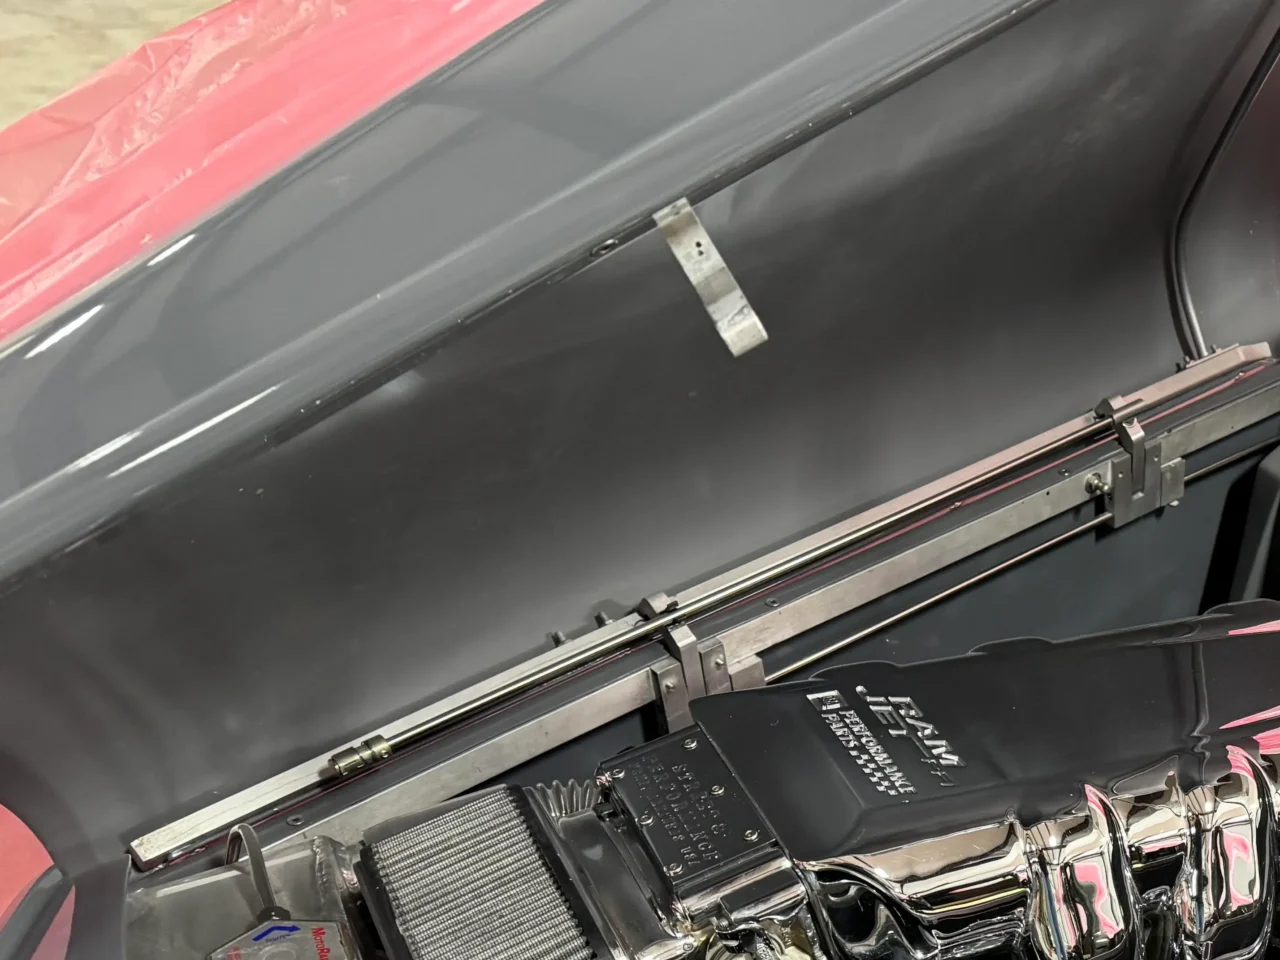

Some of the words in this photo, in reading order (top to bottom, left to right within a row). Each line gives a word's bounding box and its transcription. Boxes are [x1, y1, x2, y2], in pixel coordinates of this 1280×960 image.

[821, 713, 860, 749] PARTS
[838, 709, 916, 794] PERFORMANCE
[855, 685, 930, 758] JET
[888, 696, 966, 767] RAM
